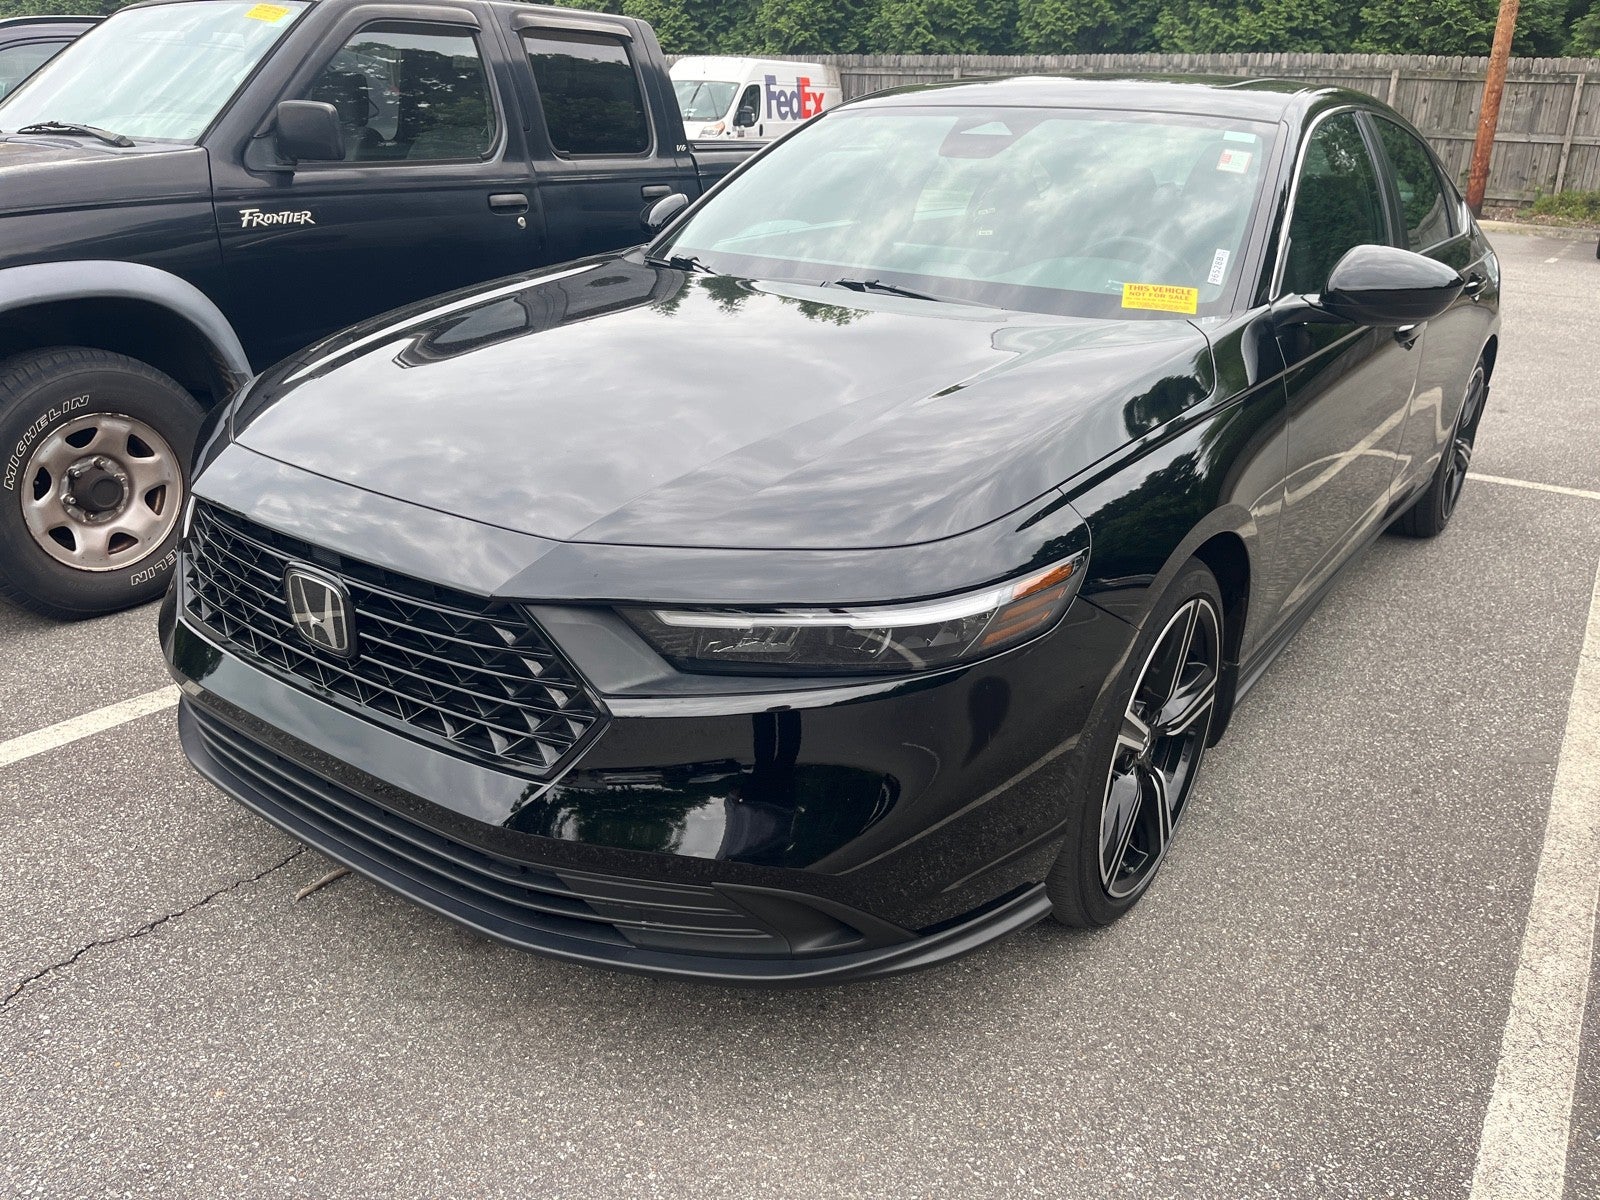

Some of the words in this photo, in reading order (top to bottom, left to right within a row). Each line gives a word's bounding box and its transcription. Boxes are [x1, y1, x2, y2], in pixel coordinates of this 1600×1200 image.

[764, 74, 824, 121] FedEx
[676, 144, 687, 152] V6
[239, 208, 316, 228] FRONTIER
[1152, 286, 1193, 295] VEHICLE
[4, 394, 90, 491] MICHELIN
[131, 549, 177, 586] ELIN
